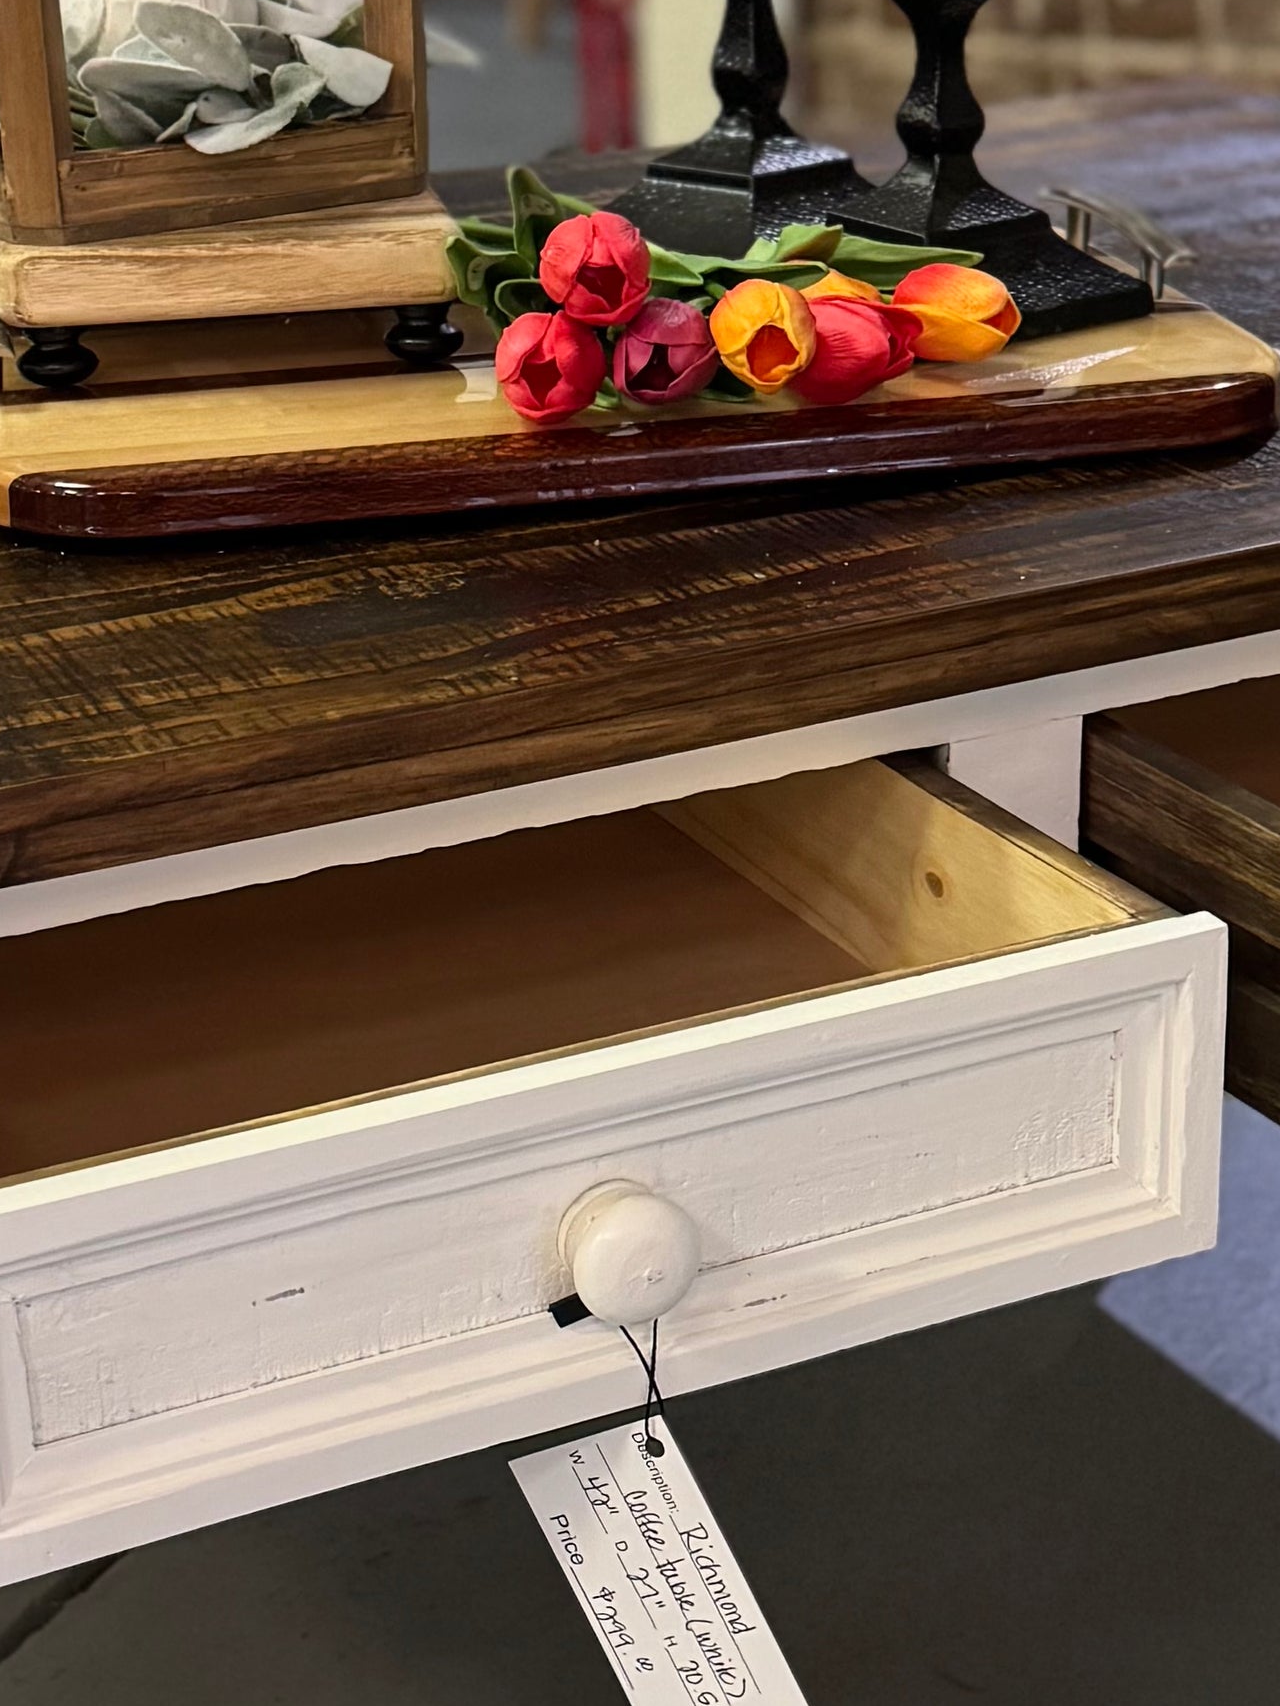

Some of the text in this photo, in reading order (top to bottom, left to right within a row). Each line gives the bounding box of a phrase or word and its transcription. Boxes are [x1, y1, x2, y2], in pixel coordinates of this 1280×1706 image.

[549, 1513, 584, 1566] Price
[568, 1449, 585, 1465] W
[615, 1541, 629, 1553] D
[663, 1635, 678, 1648] H
[631, 1432, 756, 1635] Description: Richmond
